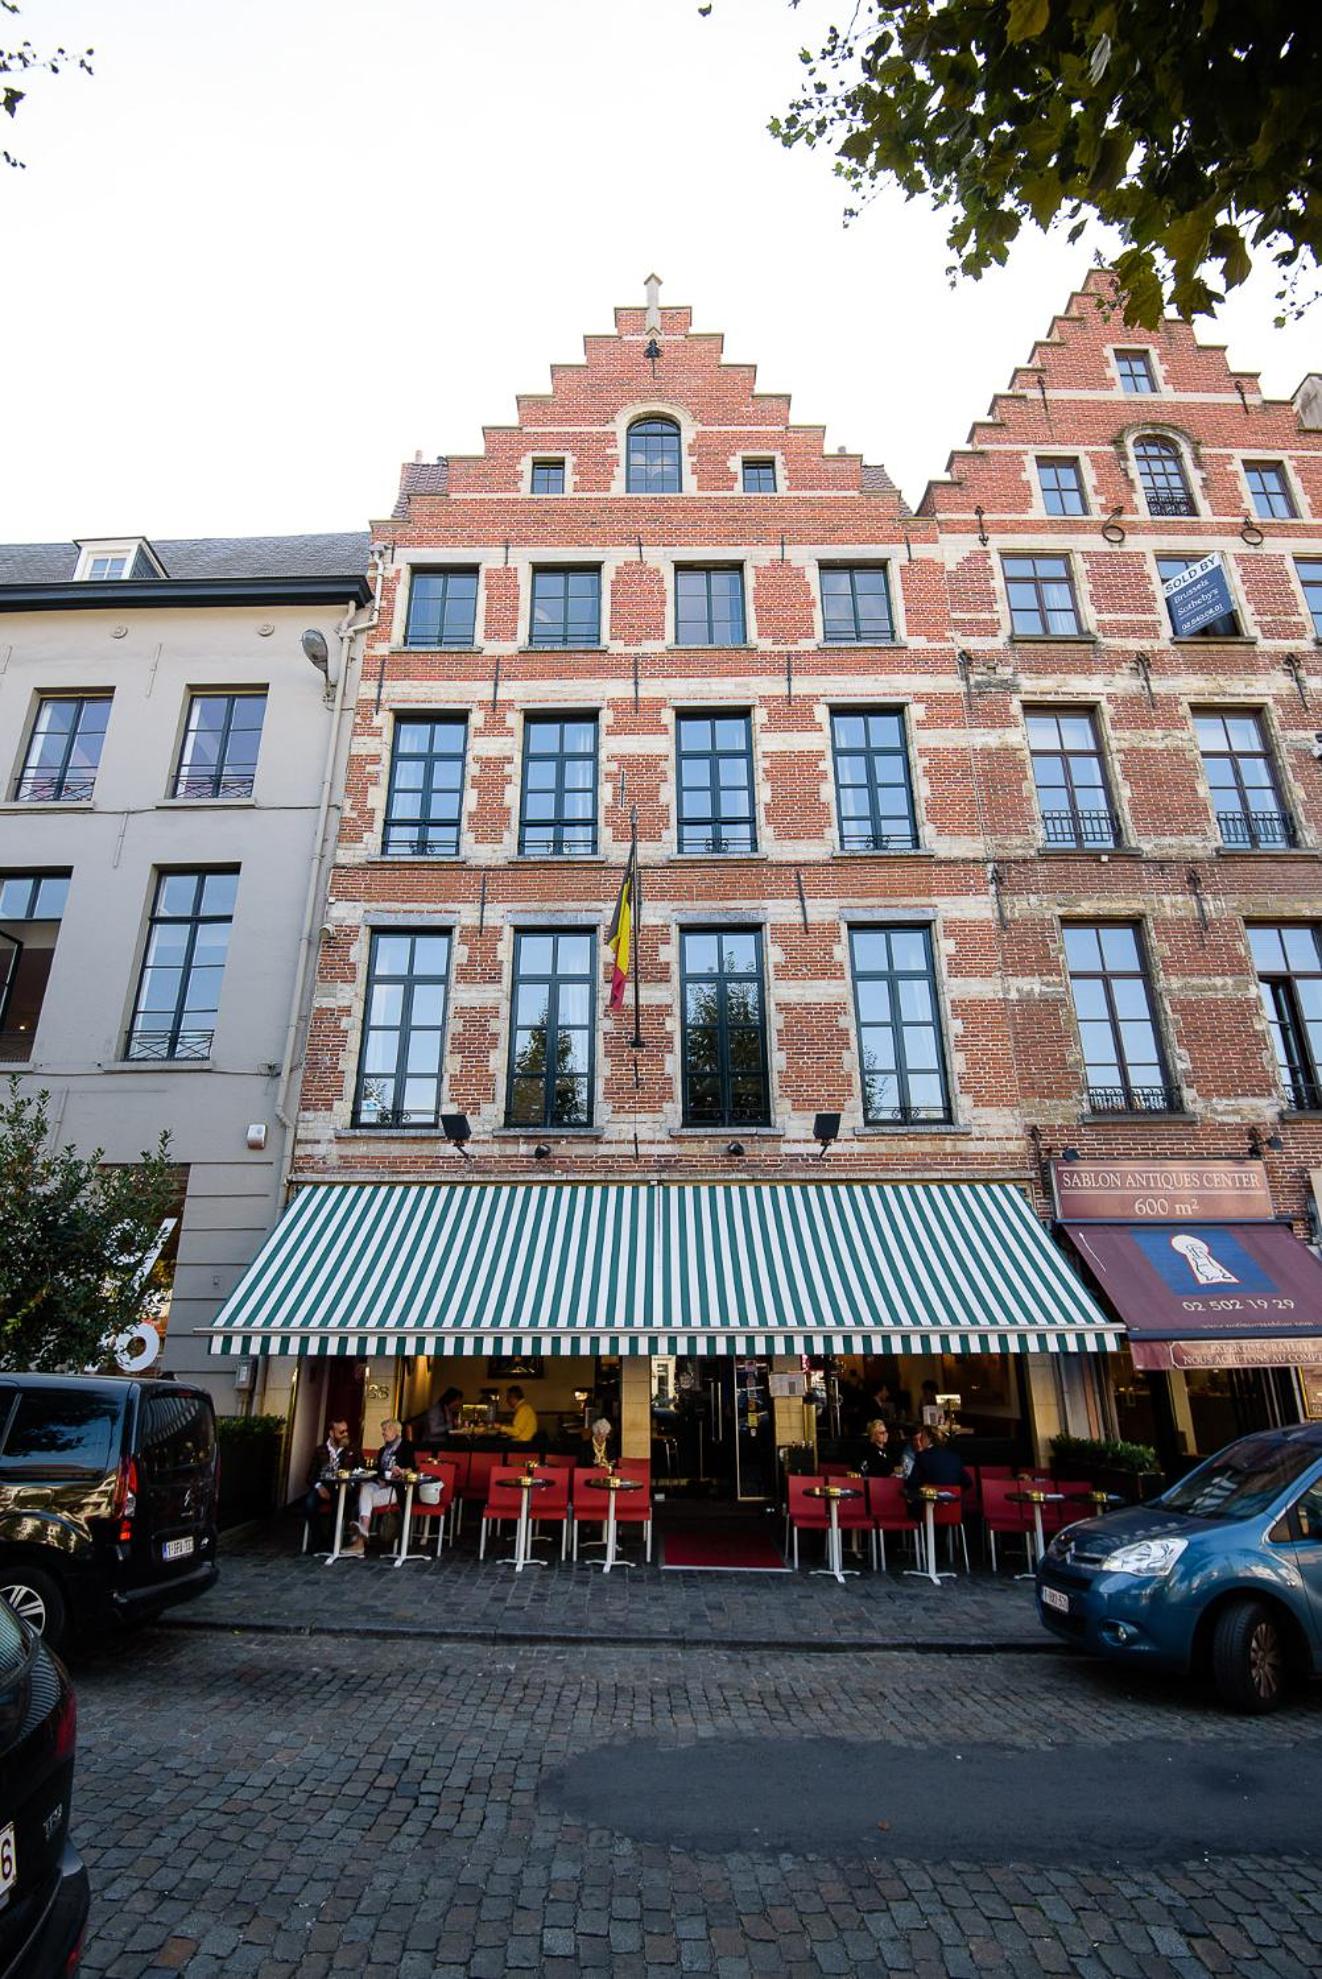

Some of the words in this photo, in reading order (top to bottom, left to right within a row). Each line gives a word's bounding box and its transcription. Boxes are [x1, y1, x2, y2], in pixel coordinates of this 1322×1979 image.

[1165, 568, 1198, 594] SOLD
[1201, 557, 1215, 572] BY
[1063, 1172, 1121, 1187] SABLON
[1126, 1172, 1200, 1190] ANTIQUES
[1203, 1172, 1260, 1187] CENTER
[1134, 1198, 1169, 1215] 600
[1182, 1301, 1206, 1311] 02
[1208, 1299, 1244, 1310] 502
[1246, 1298, 1268, 1309] 19
[1272, 1298, 1295, 1309] 29
[1183, 1355, 1213, 1365] NOUS
[1216, 1353, 1270, 1364] ACHETONS
[1272, 1352, 1286, 1362] AU
